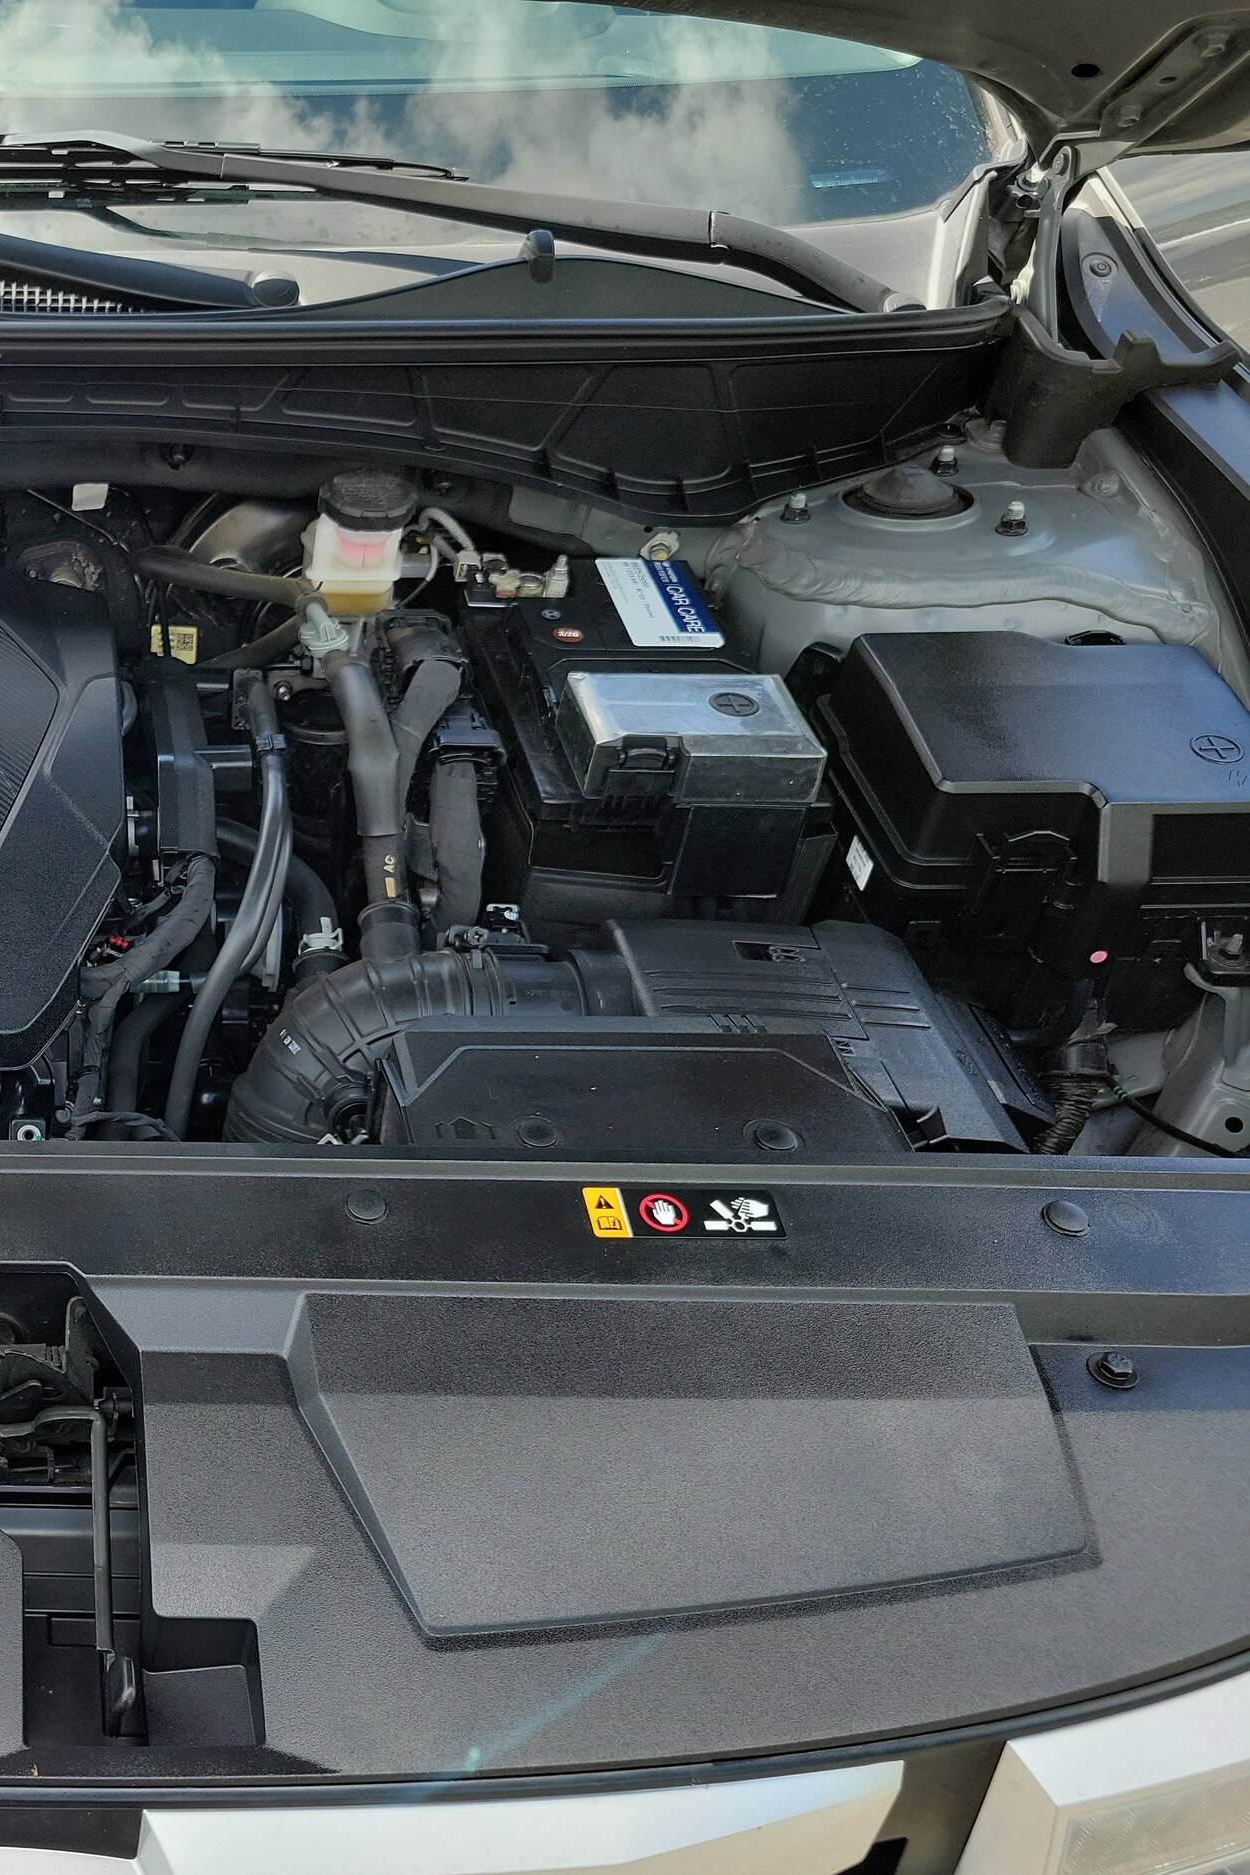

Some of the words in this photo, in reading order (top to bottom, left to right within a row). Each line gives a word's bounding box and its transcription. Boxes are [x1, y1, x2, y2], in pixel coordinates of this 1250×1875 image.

[666, 586, 690, 605] CAR
[678, 606, 706, 633] CARE
[383, 854, 395, 874] AC
